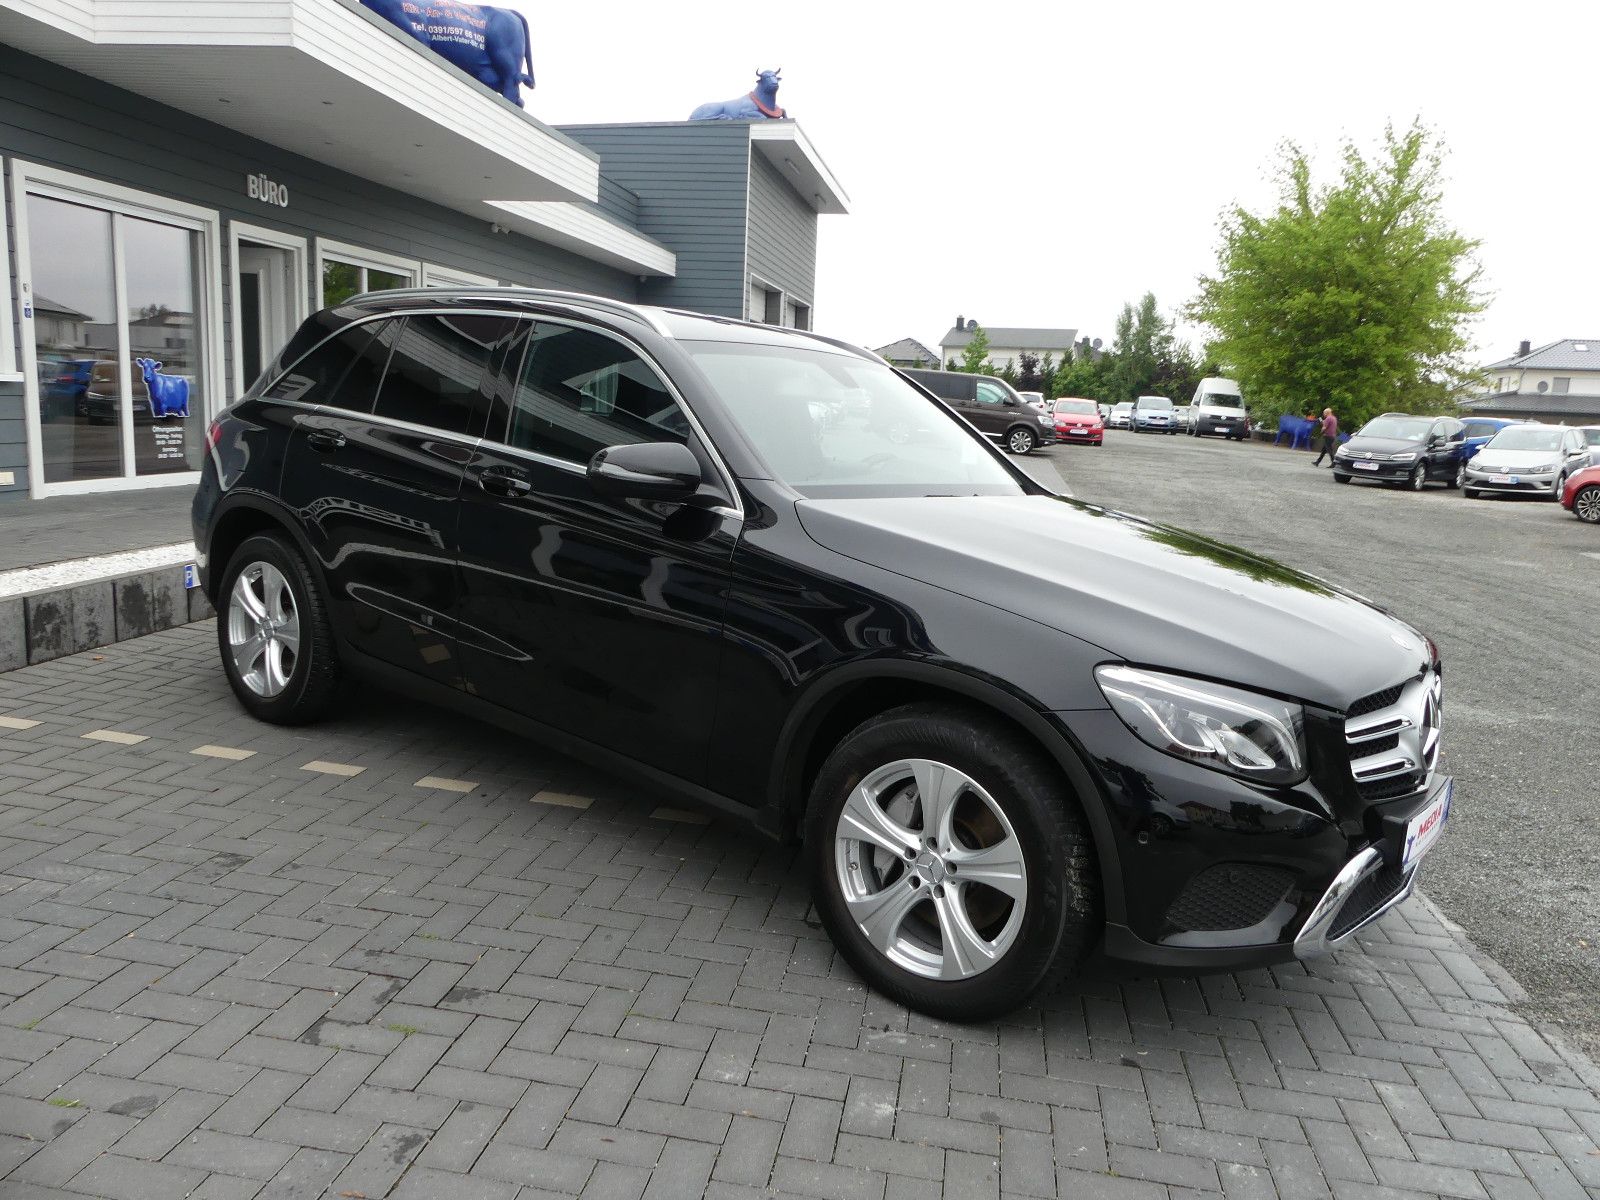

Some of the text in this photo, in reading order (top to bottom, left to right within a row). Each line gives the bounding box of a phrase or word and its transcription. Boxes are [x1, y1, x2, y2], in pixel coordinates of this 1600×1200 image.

[411, 22, 427, 32] Tel.
[428, 26, 463, 35] 0391/597
[247, 173, 288, 207] BÜRO
